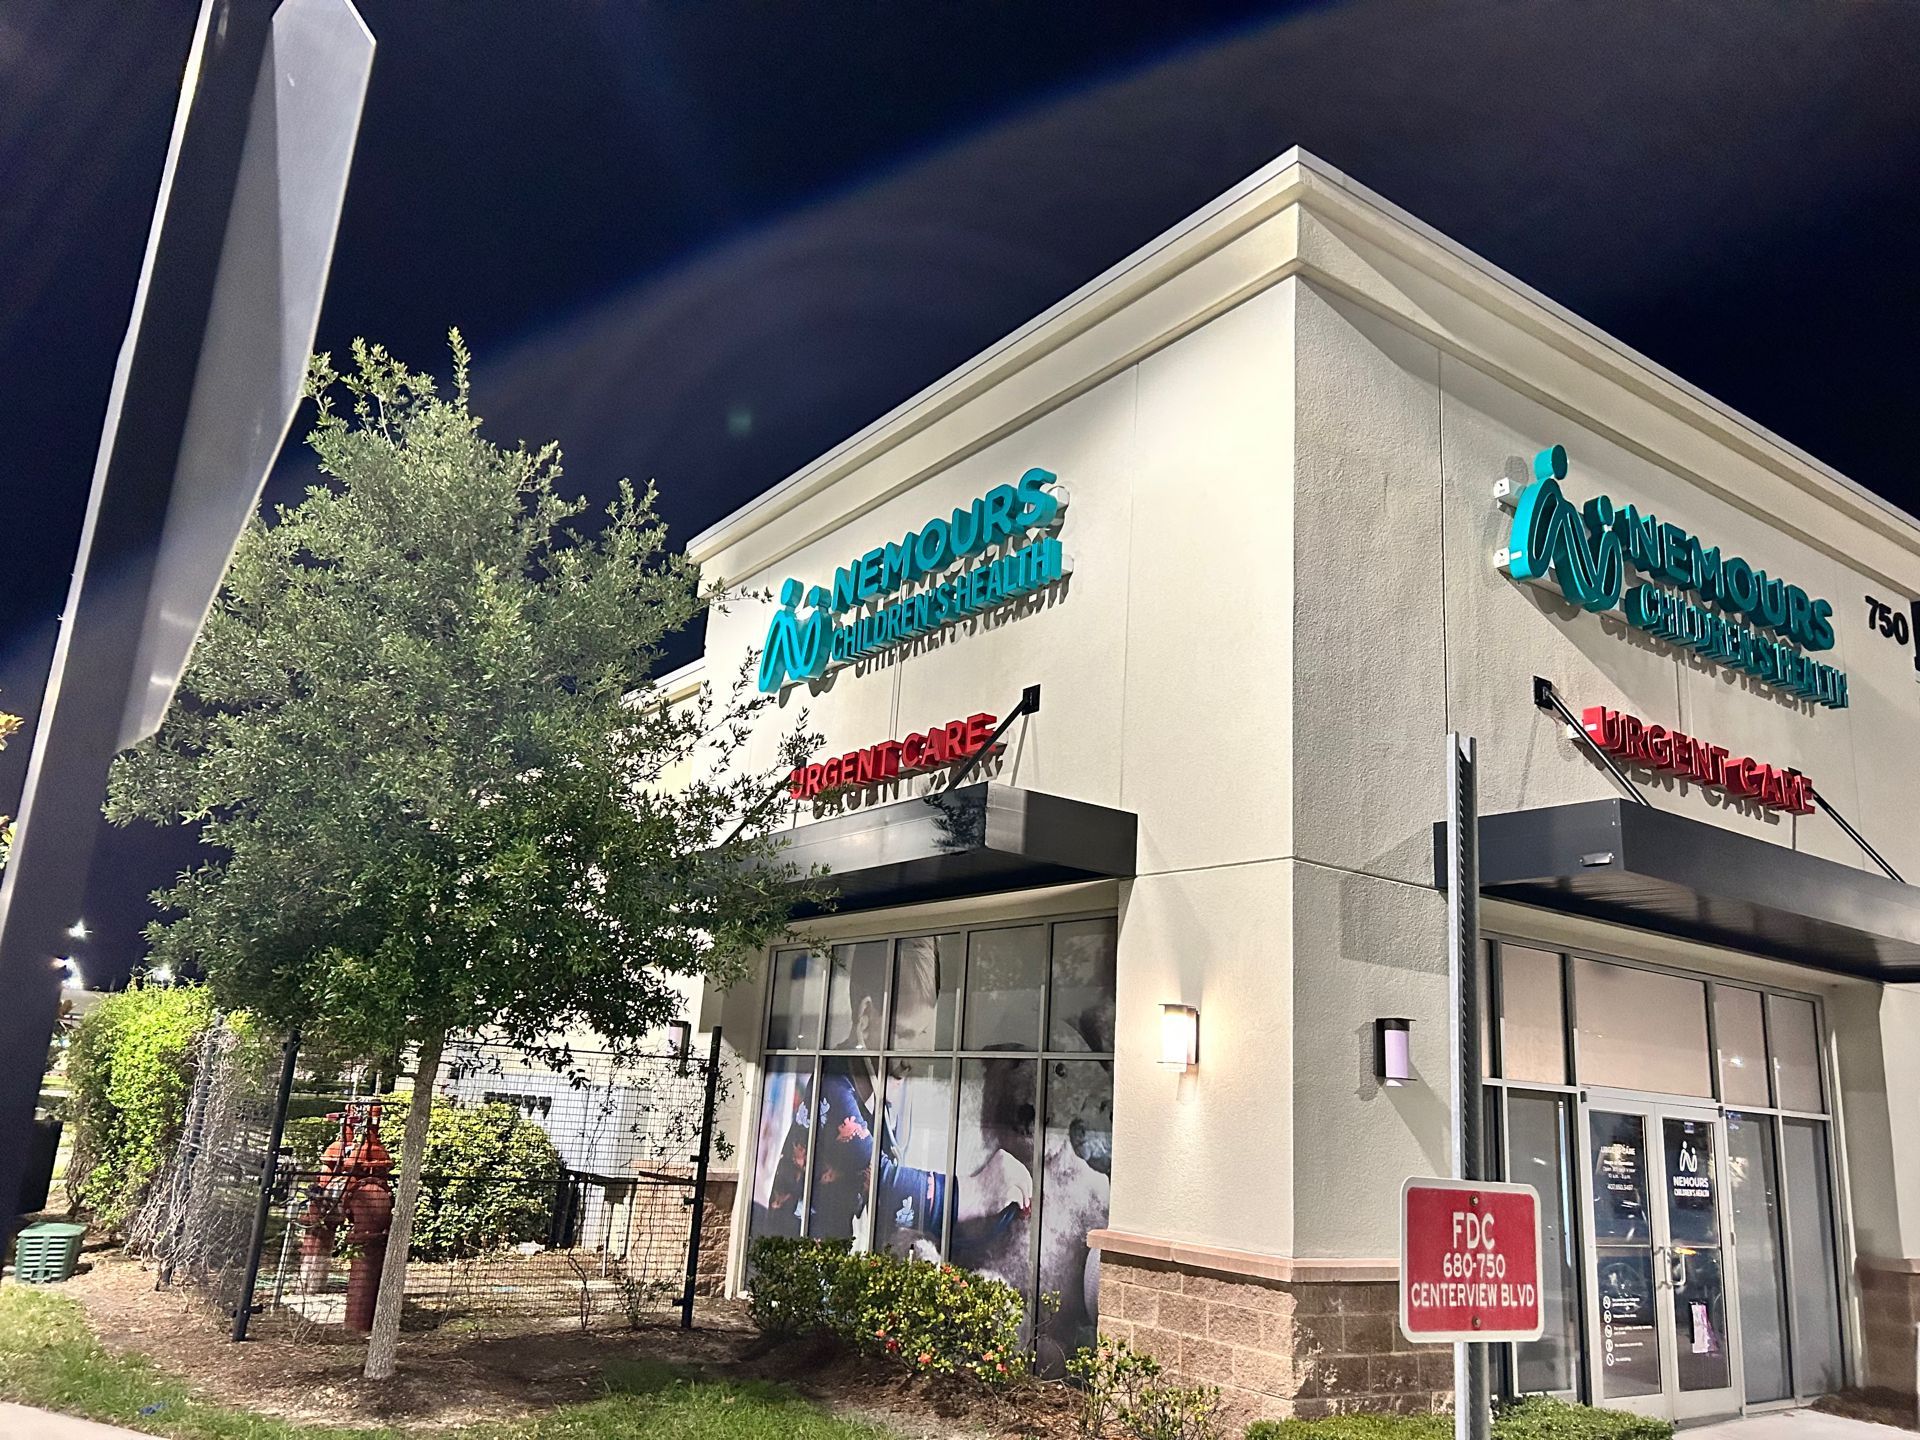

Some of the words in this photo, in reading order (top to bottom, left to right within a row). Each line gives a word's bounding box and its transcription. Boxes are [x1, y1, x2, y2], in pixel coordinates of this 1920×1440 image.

[831, 467, 1058, 613] NEMOURS
[1616, 503, 1835, 652] NEMOURS
[831, 582, 955, 661] CHILDREN'S
[955, 537, 1063, 613] HEALTH
[1864, 595, 1909, 646] 750
[1627, 583, 1774, 677] CHILDREN'S
[1768, 641, 1849, 710] HEALTH
[790, 740, 902, 799] URGENT
[901, 713, 998, 769] CARE
[1584, 705, 1729, 786] URGENT
[1728, 757, 1815, 815] CARE
[1673, 1176, 1709, 1188] NEMOURS
[1443, 1252, 1506, 1279] 680-750
[1453, 1211, 1496, 1250] FDC
[1411, 1282, 1498, 1308] CENTERVIEW
[1501, 1283, 1535, 1308] BLVD
